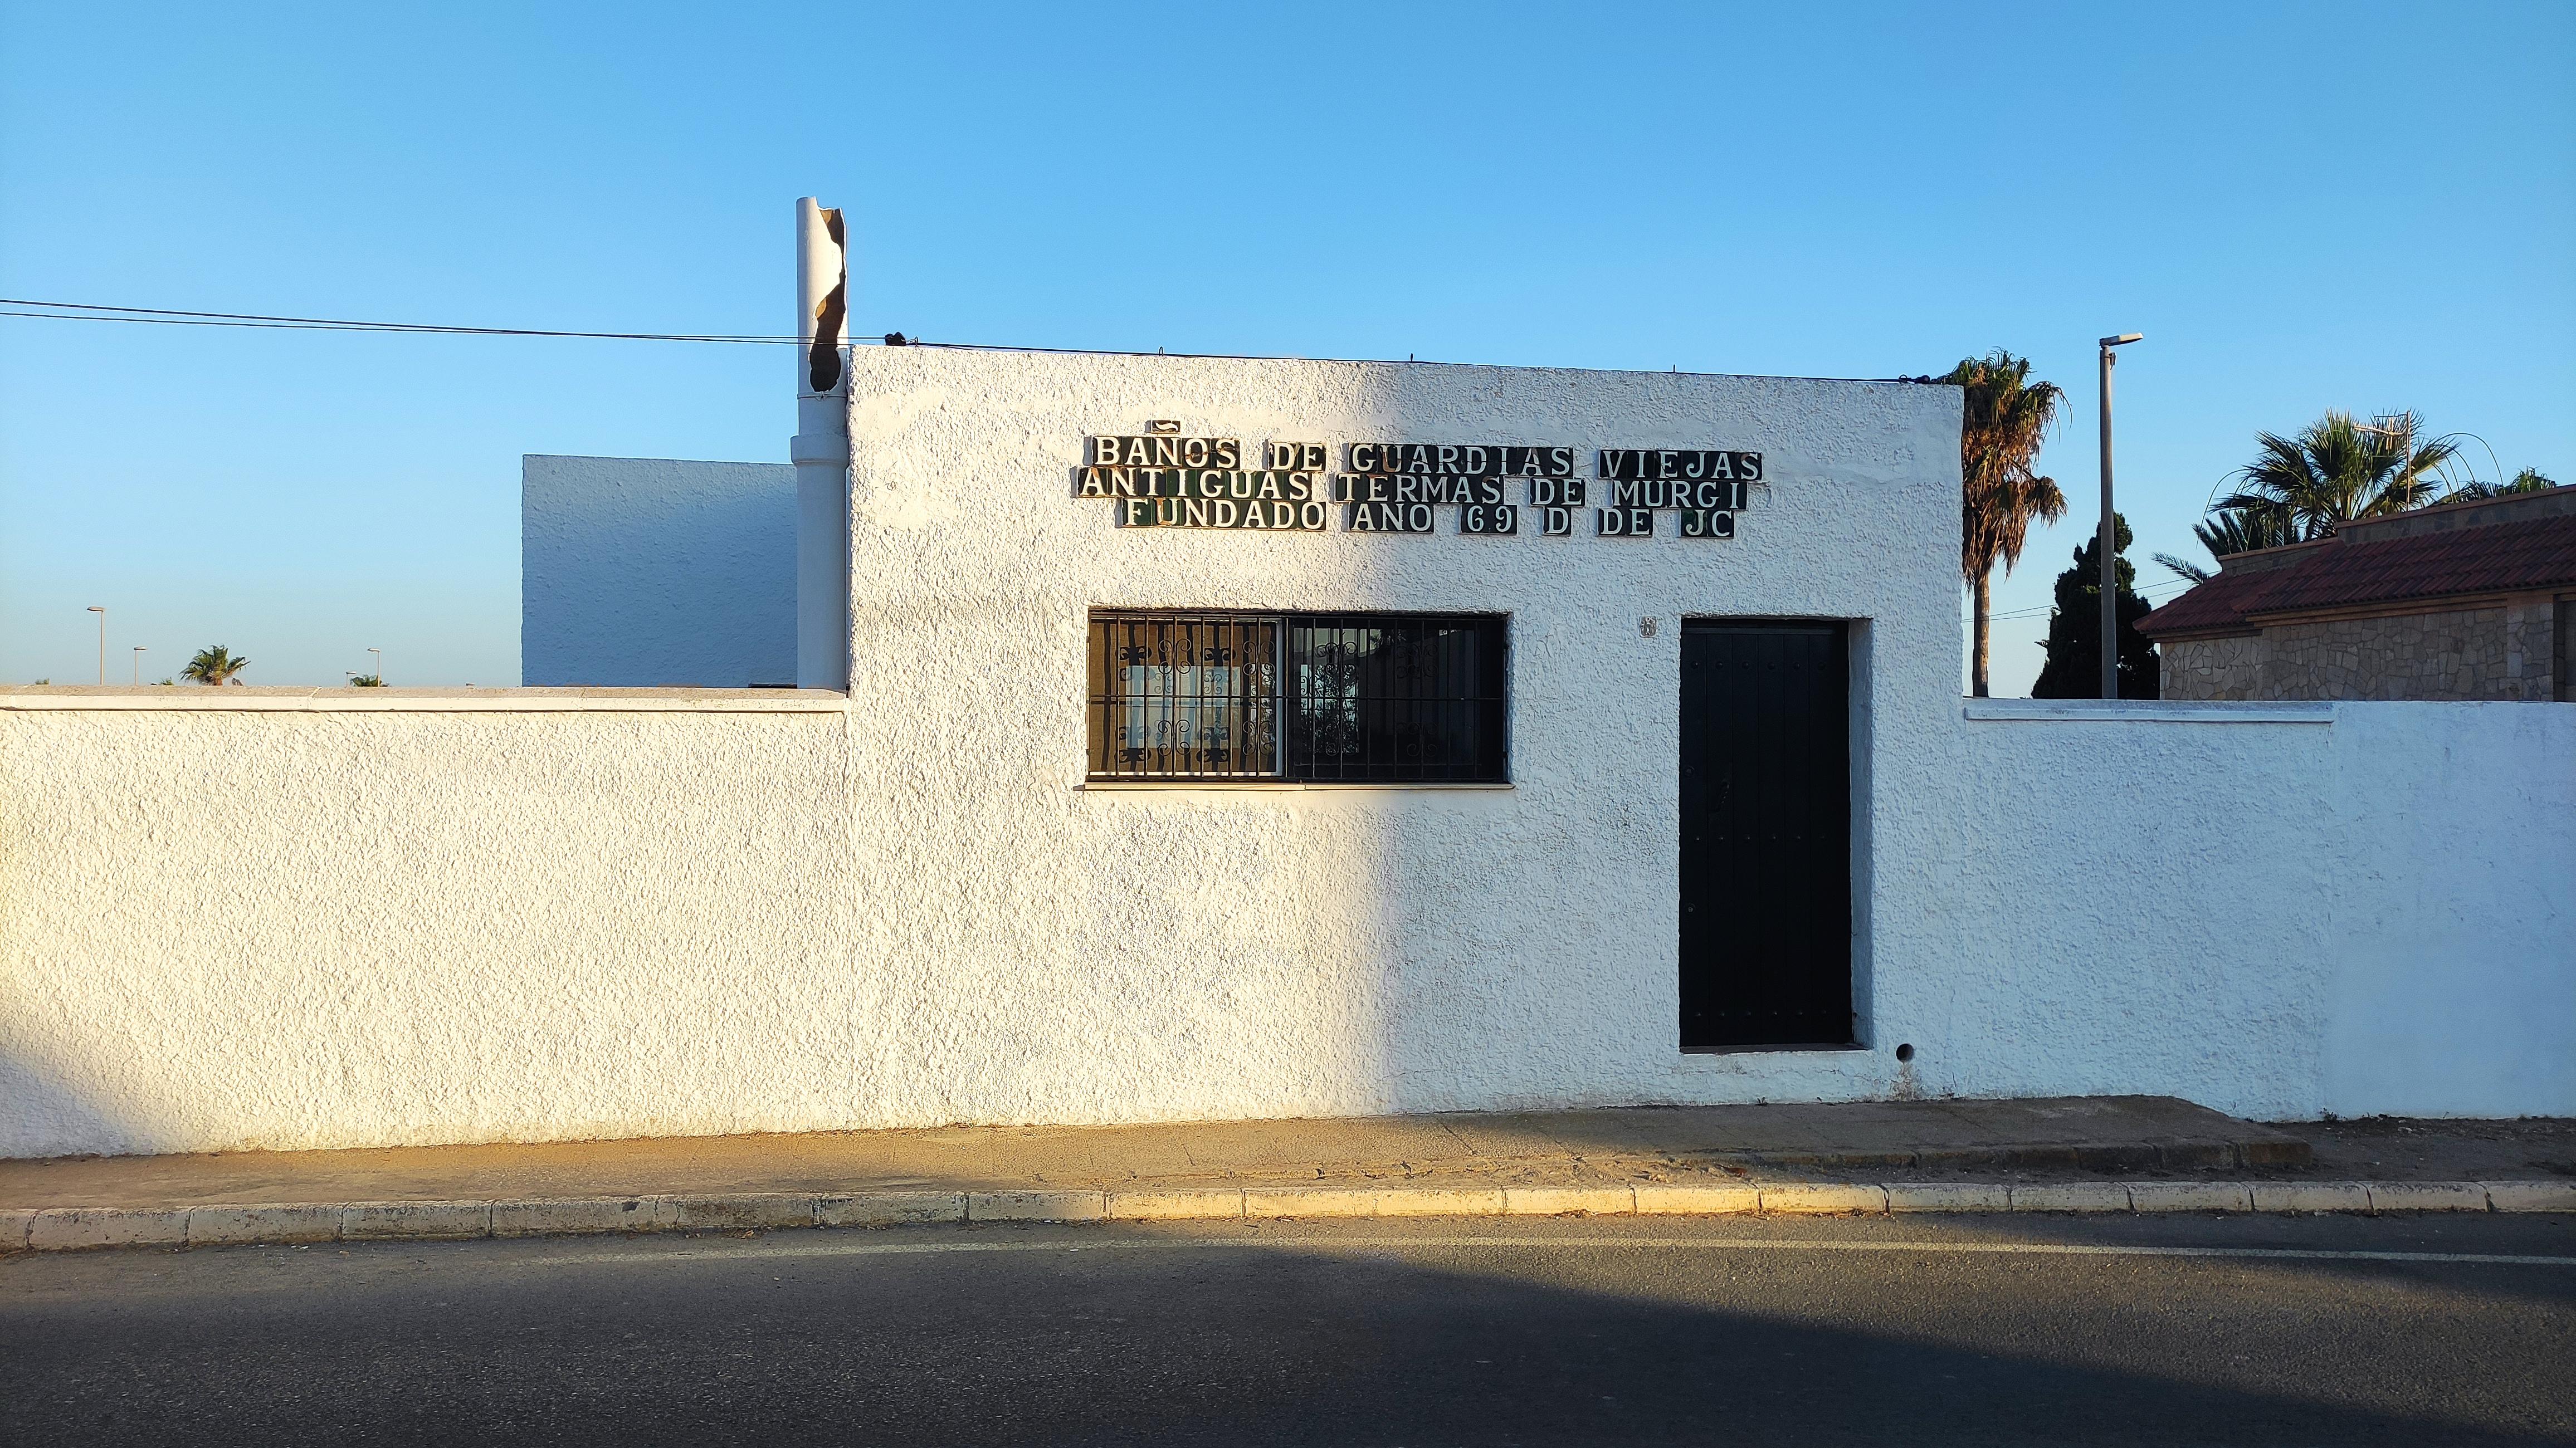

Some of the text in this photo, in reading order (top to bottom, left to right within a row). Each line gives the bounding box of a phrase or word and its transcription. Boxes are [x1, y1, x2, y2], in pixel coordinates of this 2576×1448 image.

[1271, 443, 1323, 471] DE
[1352, 444, 1570, 476] GUARDIAS
[1602, 451, 1759, 480] VIEJAS
[1078, 467, 1739, 508] ANTIGUAS TERMAS DE MURGI
[1124, 498, 1732, 537] FUNDADO ANO 69 D DE JC
